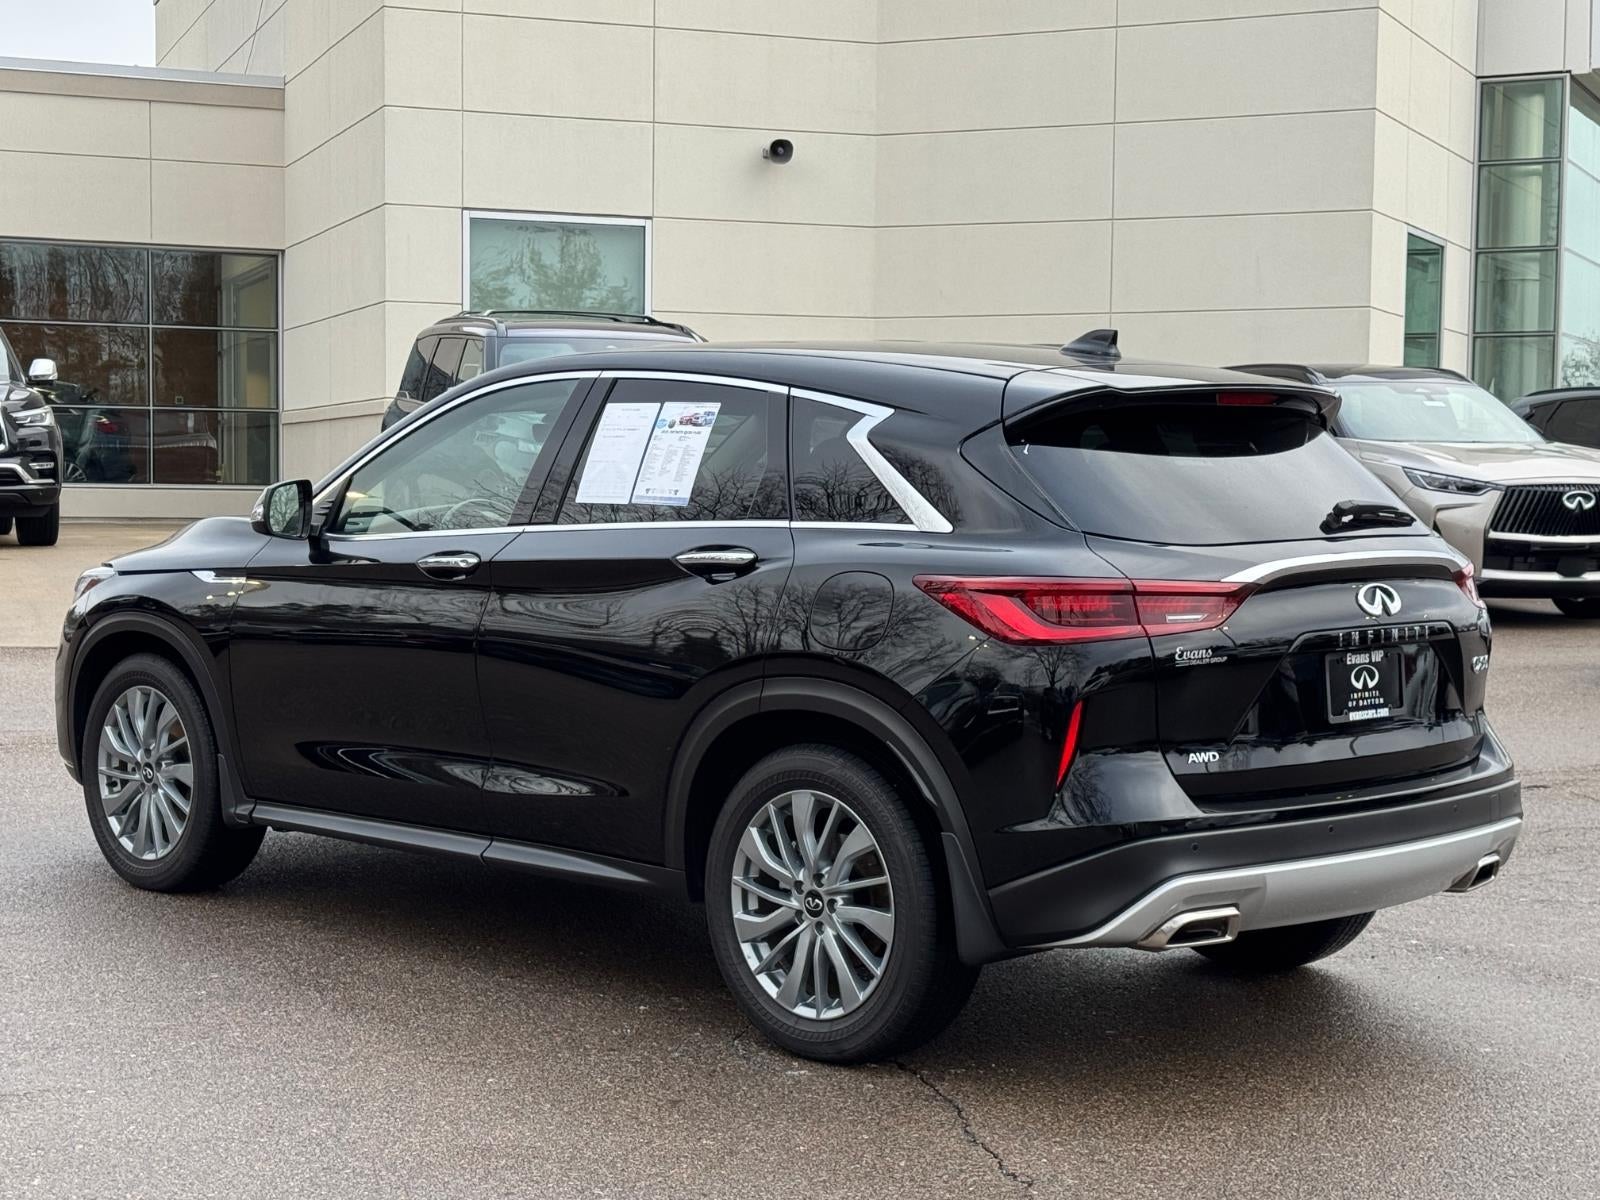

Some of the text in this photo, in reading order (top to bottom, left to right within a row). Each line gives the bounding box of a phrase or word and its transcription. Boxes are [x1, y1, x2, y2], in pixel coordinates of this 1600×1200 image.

[1339, 625, 1429, 647] INFINITI
[1175, 646, 1212, 661] Evans
[1346, 650, 1383, 664] Evans VIP
[1350, 690, 1379, 699] INFINITI
[1359, 698, 1383, 707] DAYTON
[1188, 751, 1220, 764] AWD
